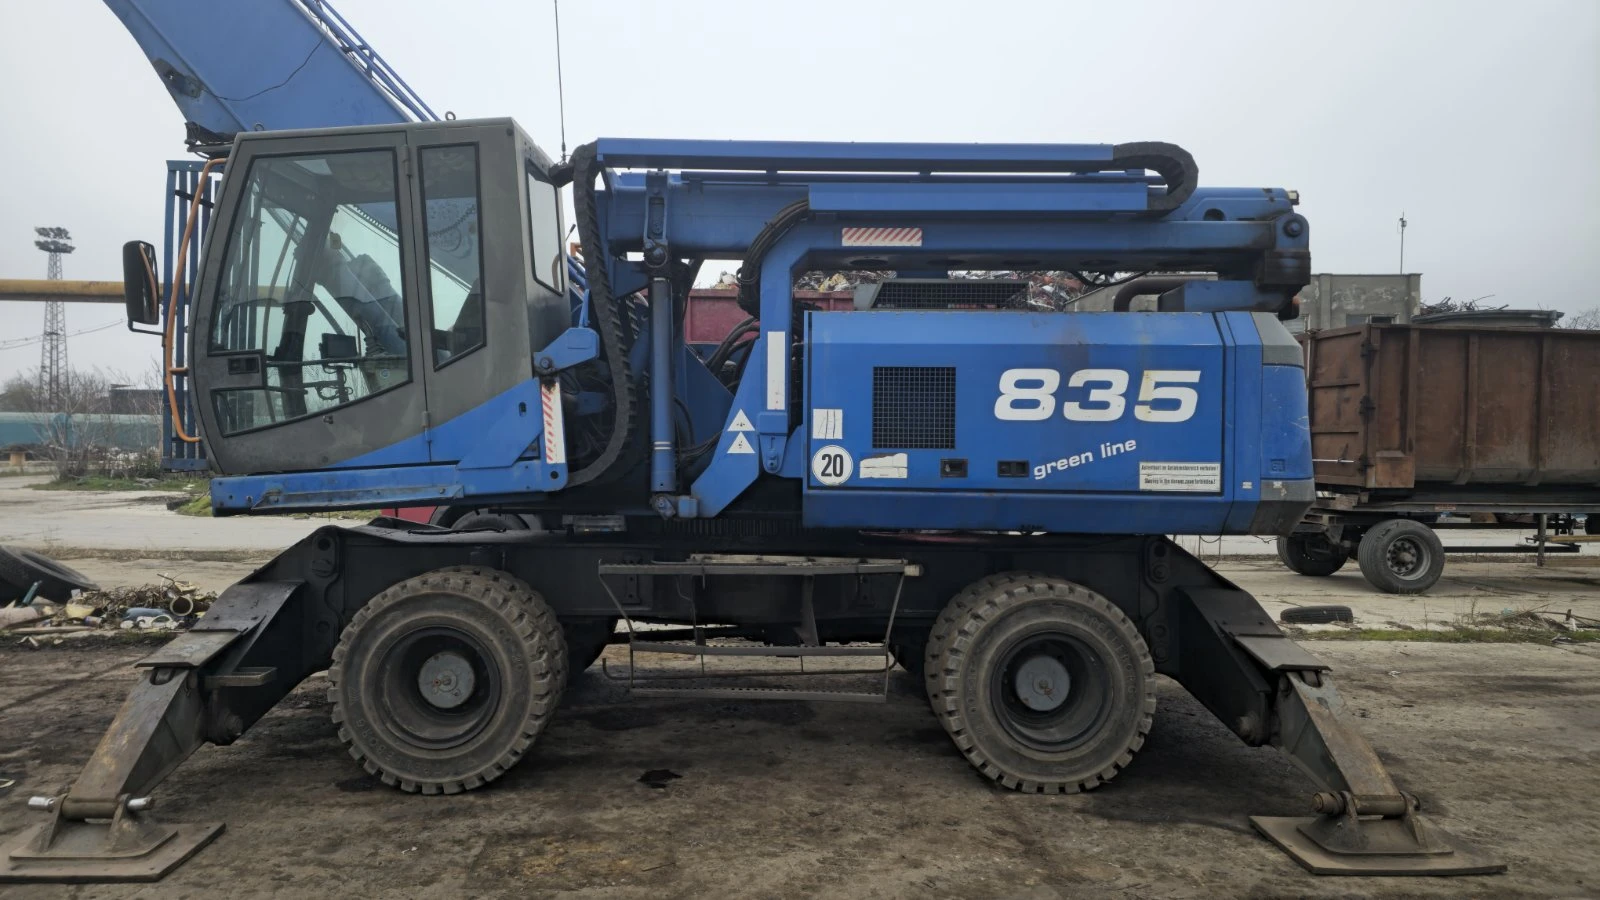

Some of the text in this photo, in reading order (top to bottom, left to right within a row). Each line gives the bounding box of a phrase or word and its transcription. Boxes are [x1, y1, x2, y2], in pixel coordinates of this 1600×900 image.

[994, 368, 1201, 423] 835
[820, 453, 844, 478] 20
[1033, 439, 1137, 480] green line
